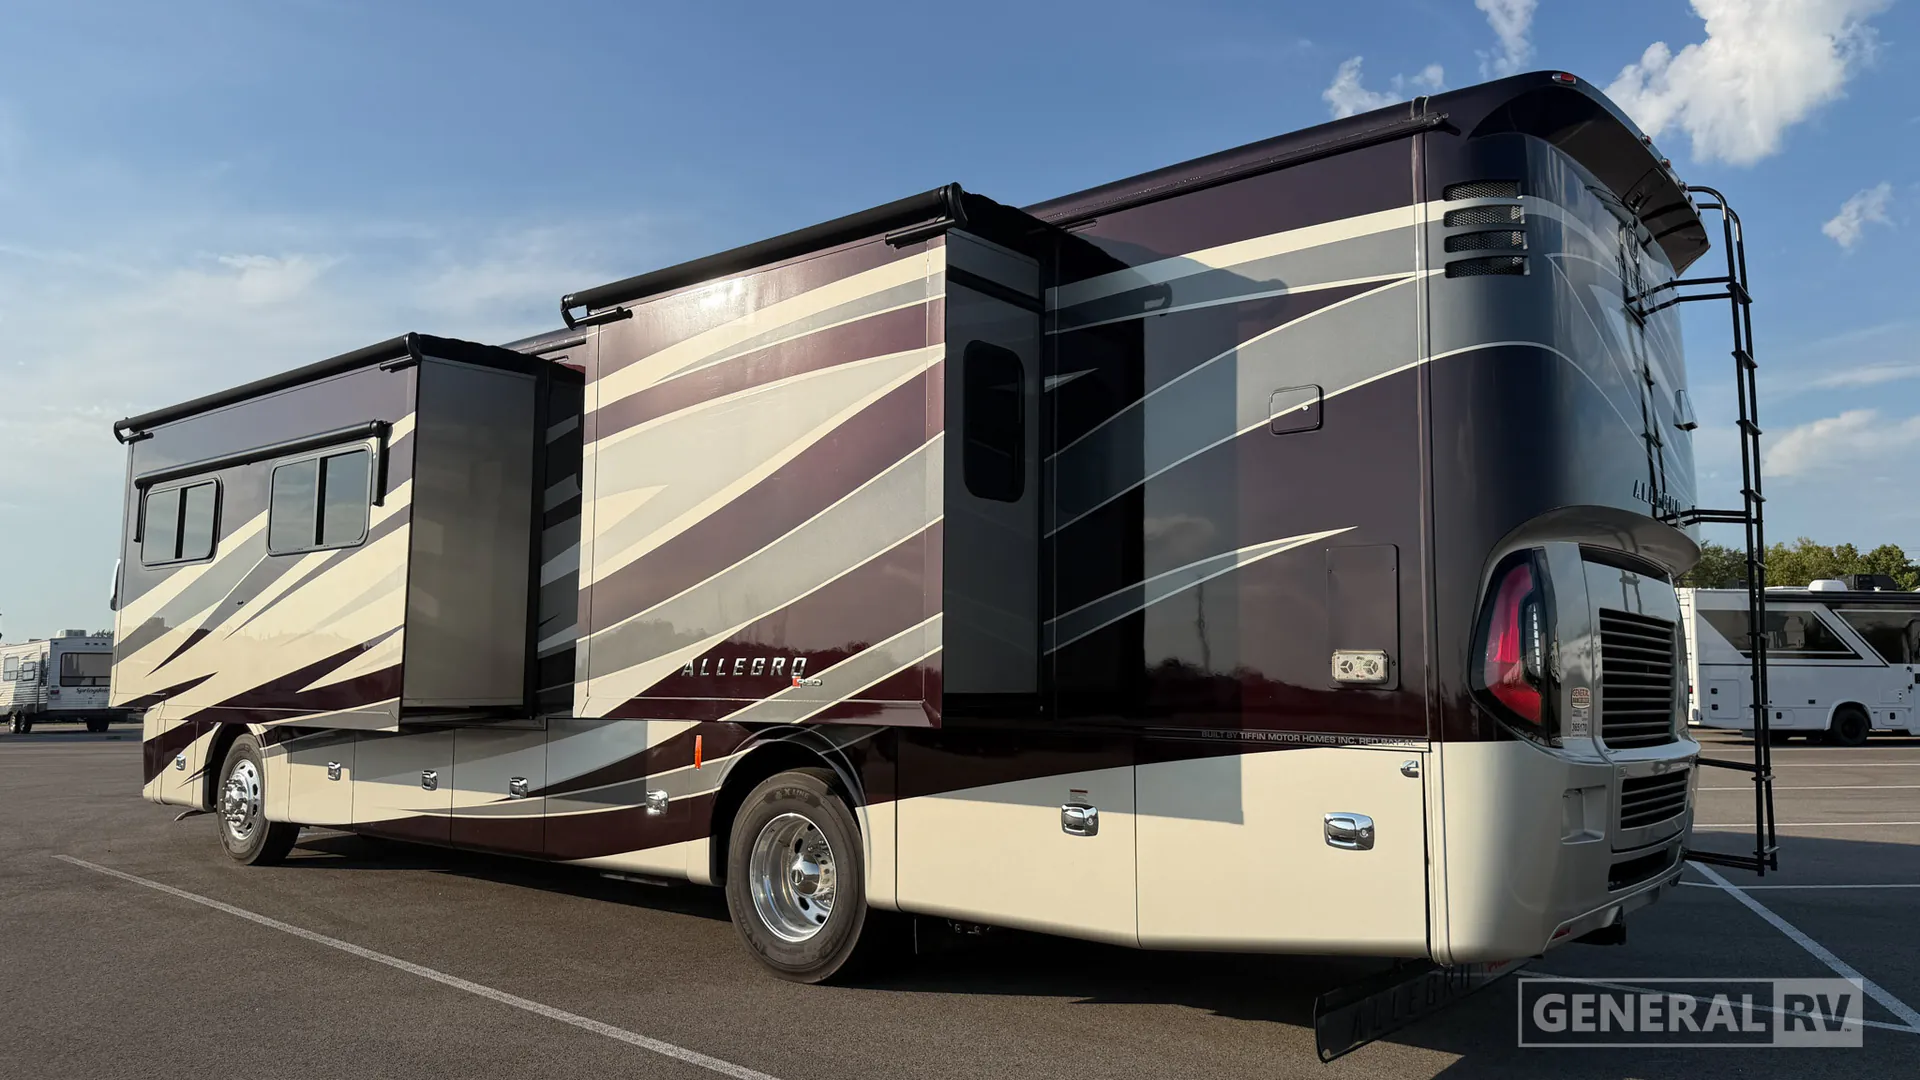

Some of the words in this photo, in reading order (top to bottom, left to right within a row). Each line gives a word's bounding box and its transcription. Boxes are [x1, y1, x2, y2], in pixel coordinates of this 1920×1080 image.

[681, 657, 807, 677] ALLEGRO
[1201, 730, 1225, 739] BUILT
[1226, 731, 1239, 739] BY
[1240, 732, 1266, 741] TIFFIN
[1268, 732, 1300, 742] MOTOR
[1302, 734, 1336, 743] HOMES
[1338, 735, 1357, 745] INC.
[1359, 736, 1378, 745] RED
